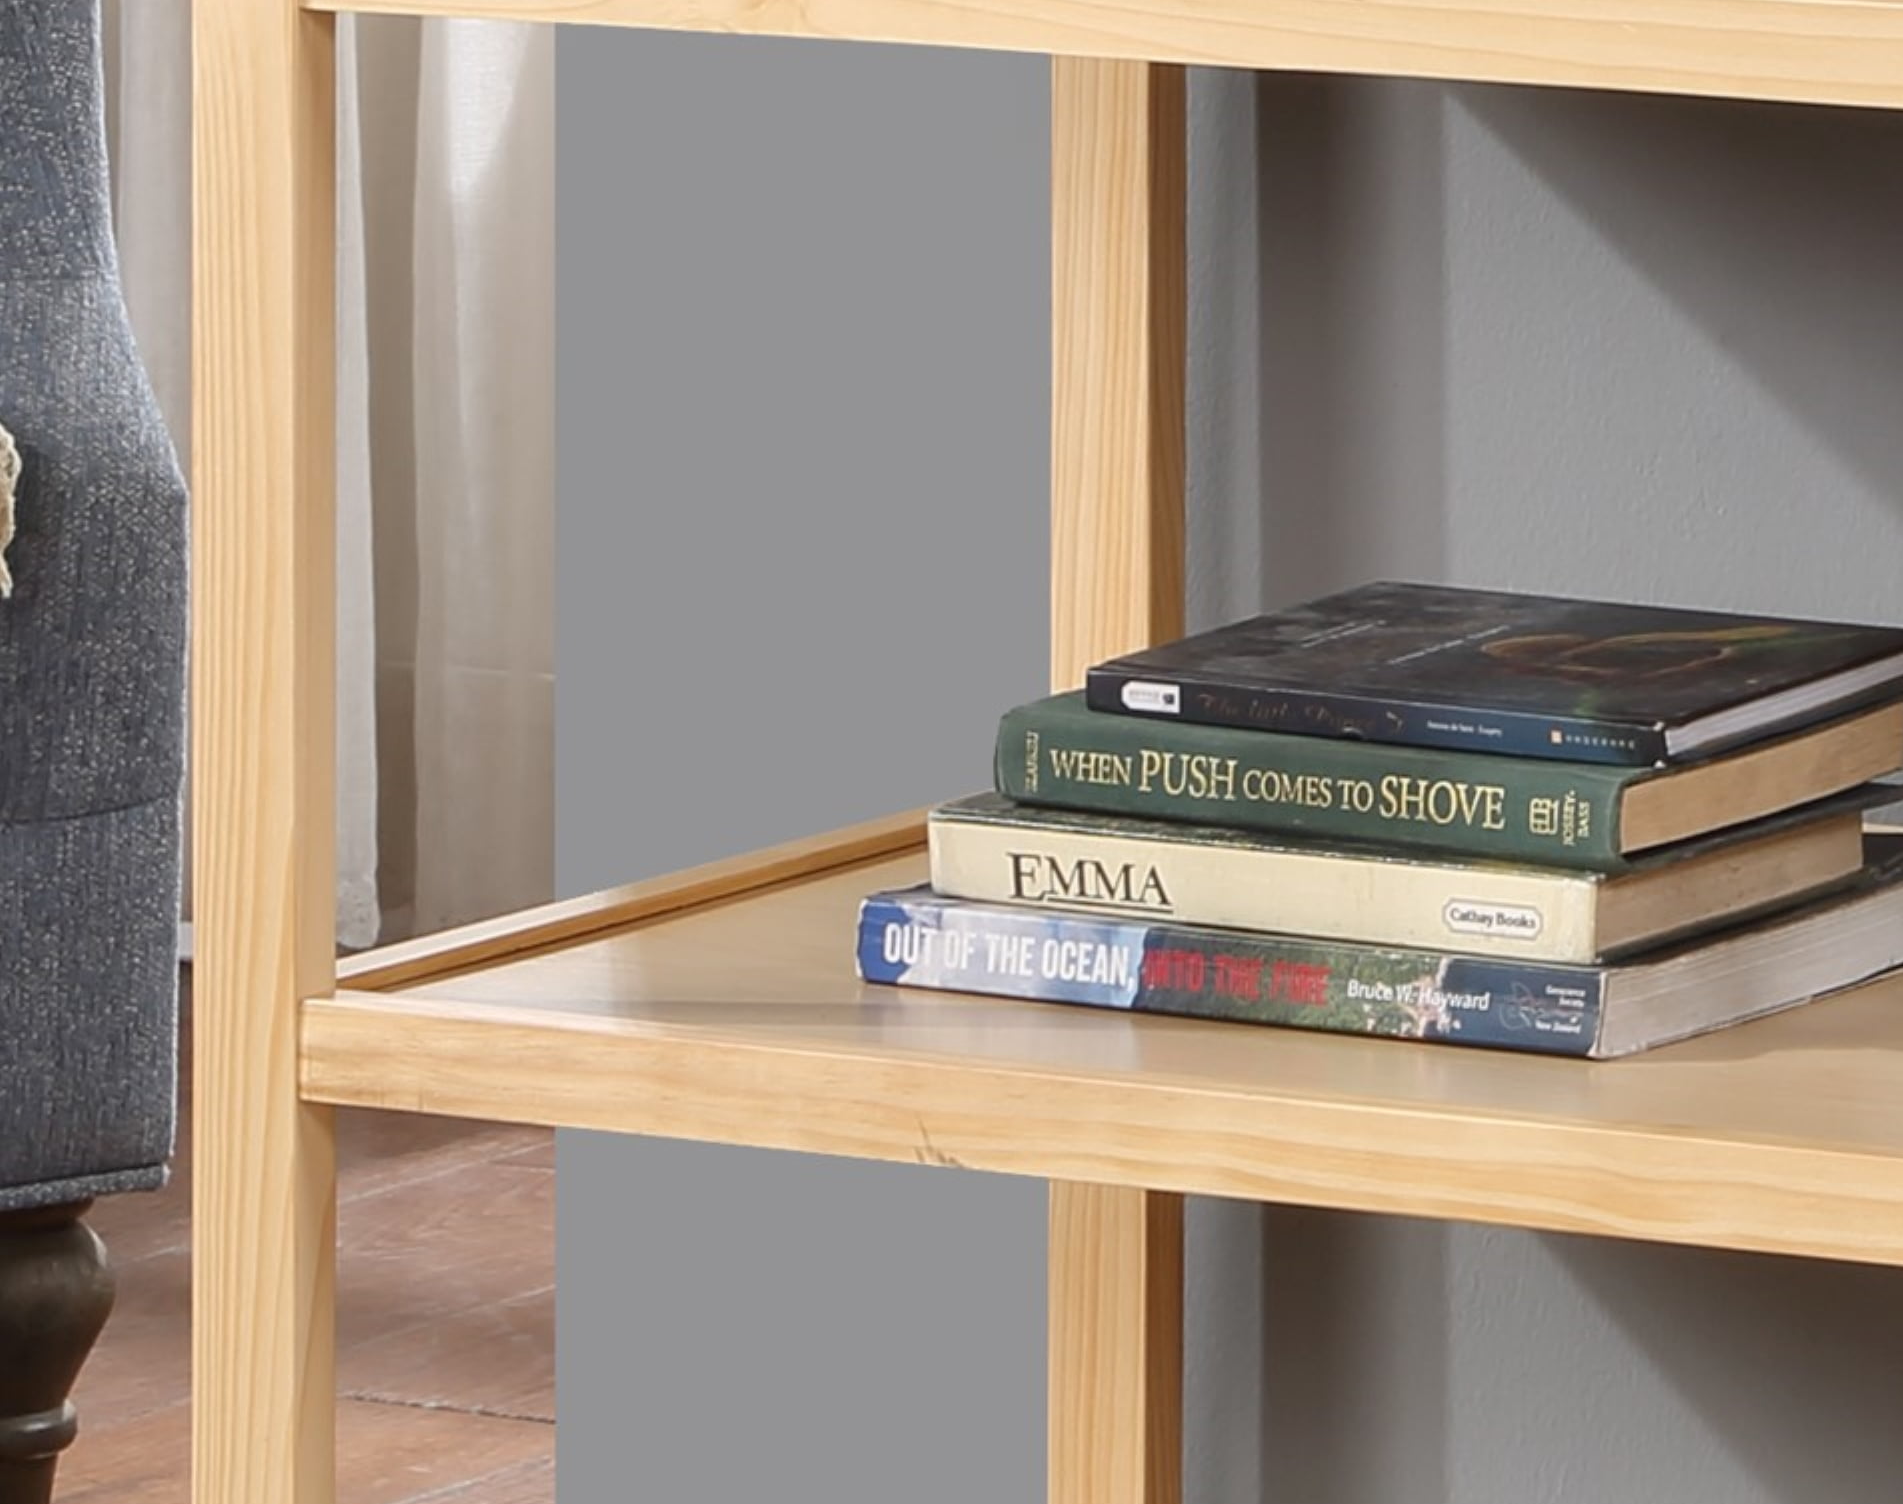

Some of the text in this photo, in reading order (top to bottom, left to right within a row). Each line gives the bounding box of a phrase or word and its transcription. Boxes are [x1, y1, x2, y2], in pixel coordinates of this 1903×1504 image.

[1049, 748, 1506, 830] WHEN PUSH COMES TO SHOVE
[1007, 852, 1173, 906] EMMA
[1496, 911, 1536, 929] Books
[884, 922, 1333, 1007] OUT OF THE OCEAN, INTO THE FIRE
[1347, 978, 1393, 1002] Bruce
[1417, 988, 1491, 1012] Hayward
